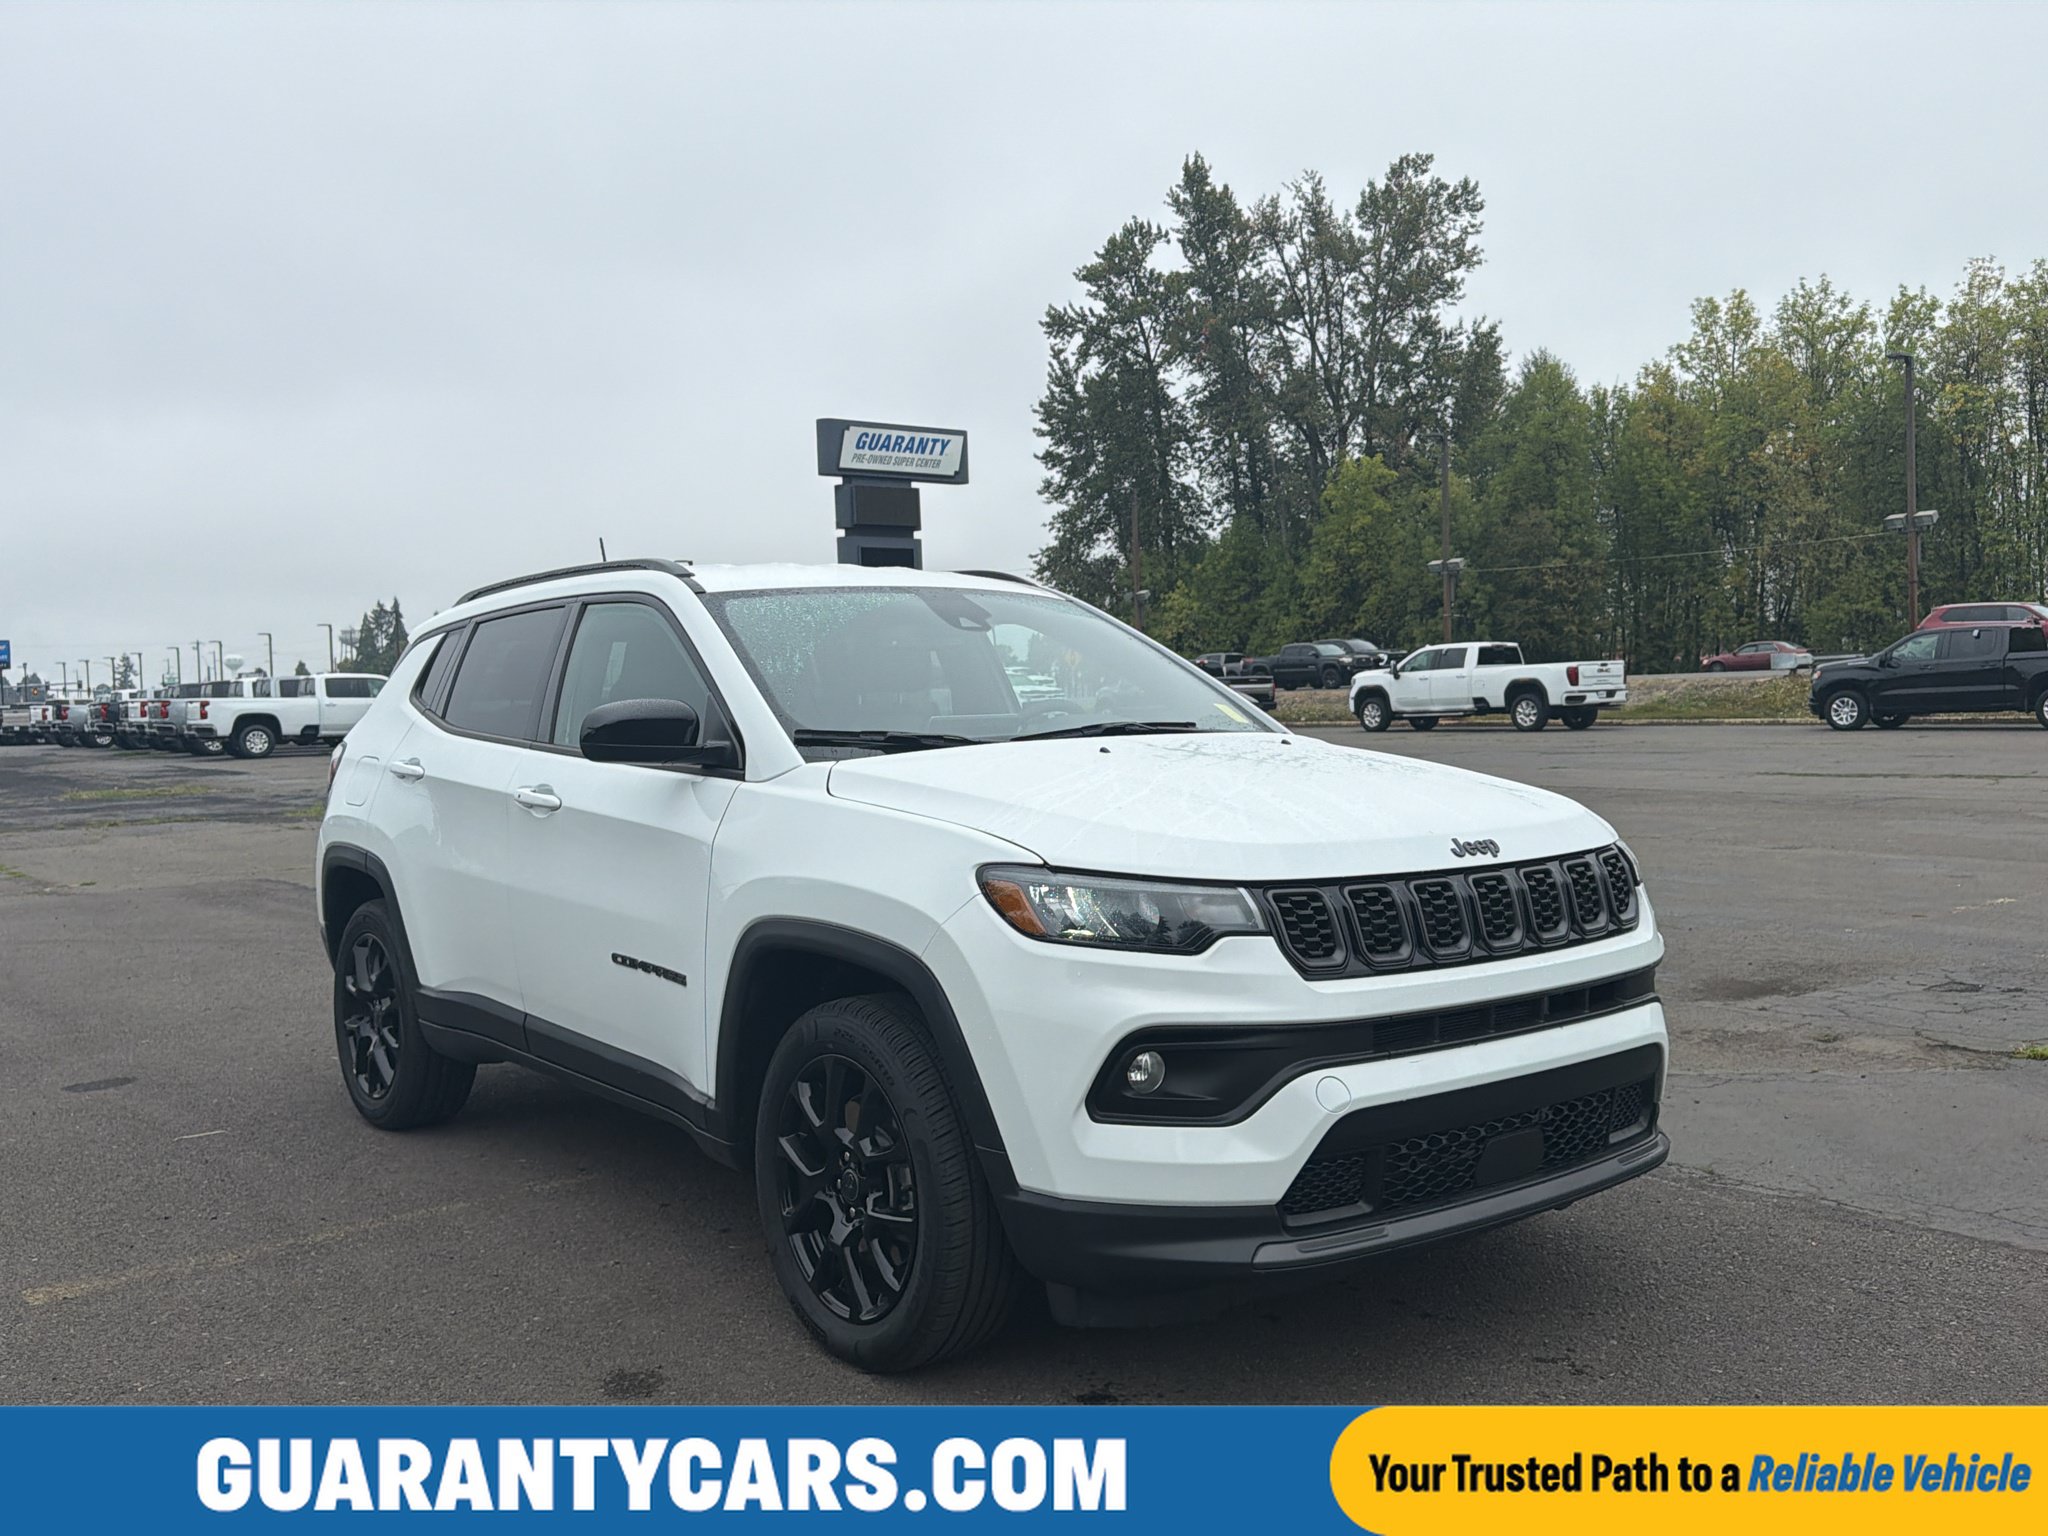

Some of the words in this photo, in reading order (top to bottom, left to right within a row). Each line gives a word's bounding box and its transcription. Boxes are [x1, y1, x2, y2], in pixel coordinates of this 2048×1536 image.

[855, 432, 951, 456] GUARANTY
[851, 453, 893, 466] PRE-OWNED
[892, 456, 914, 467] SUPER
[915, 458, 942, 469] CENTER
[1450, 838, 1500, 858] Jeep
